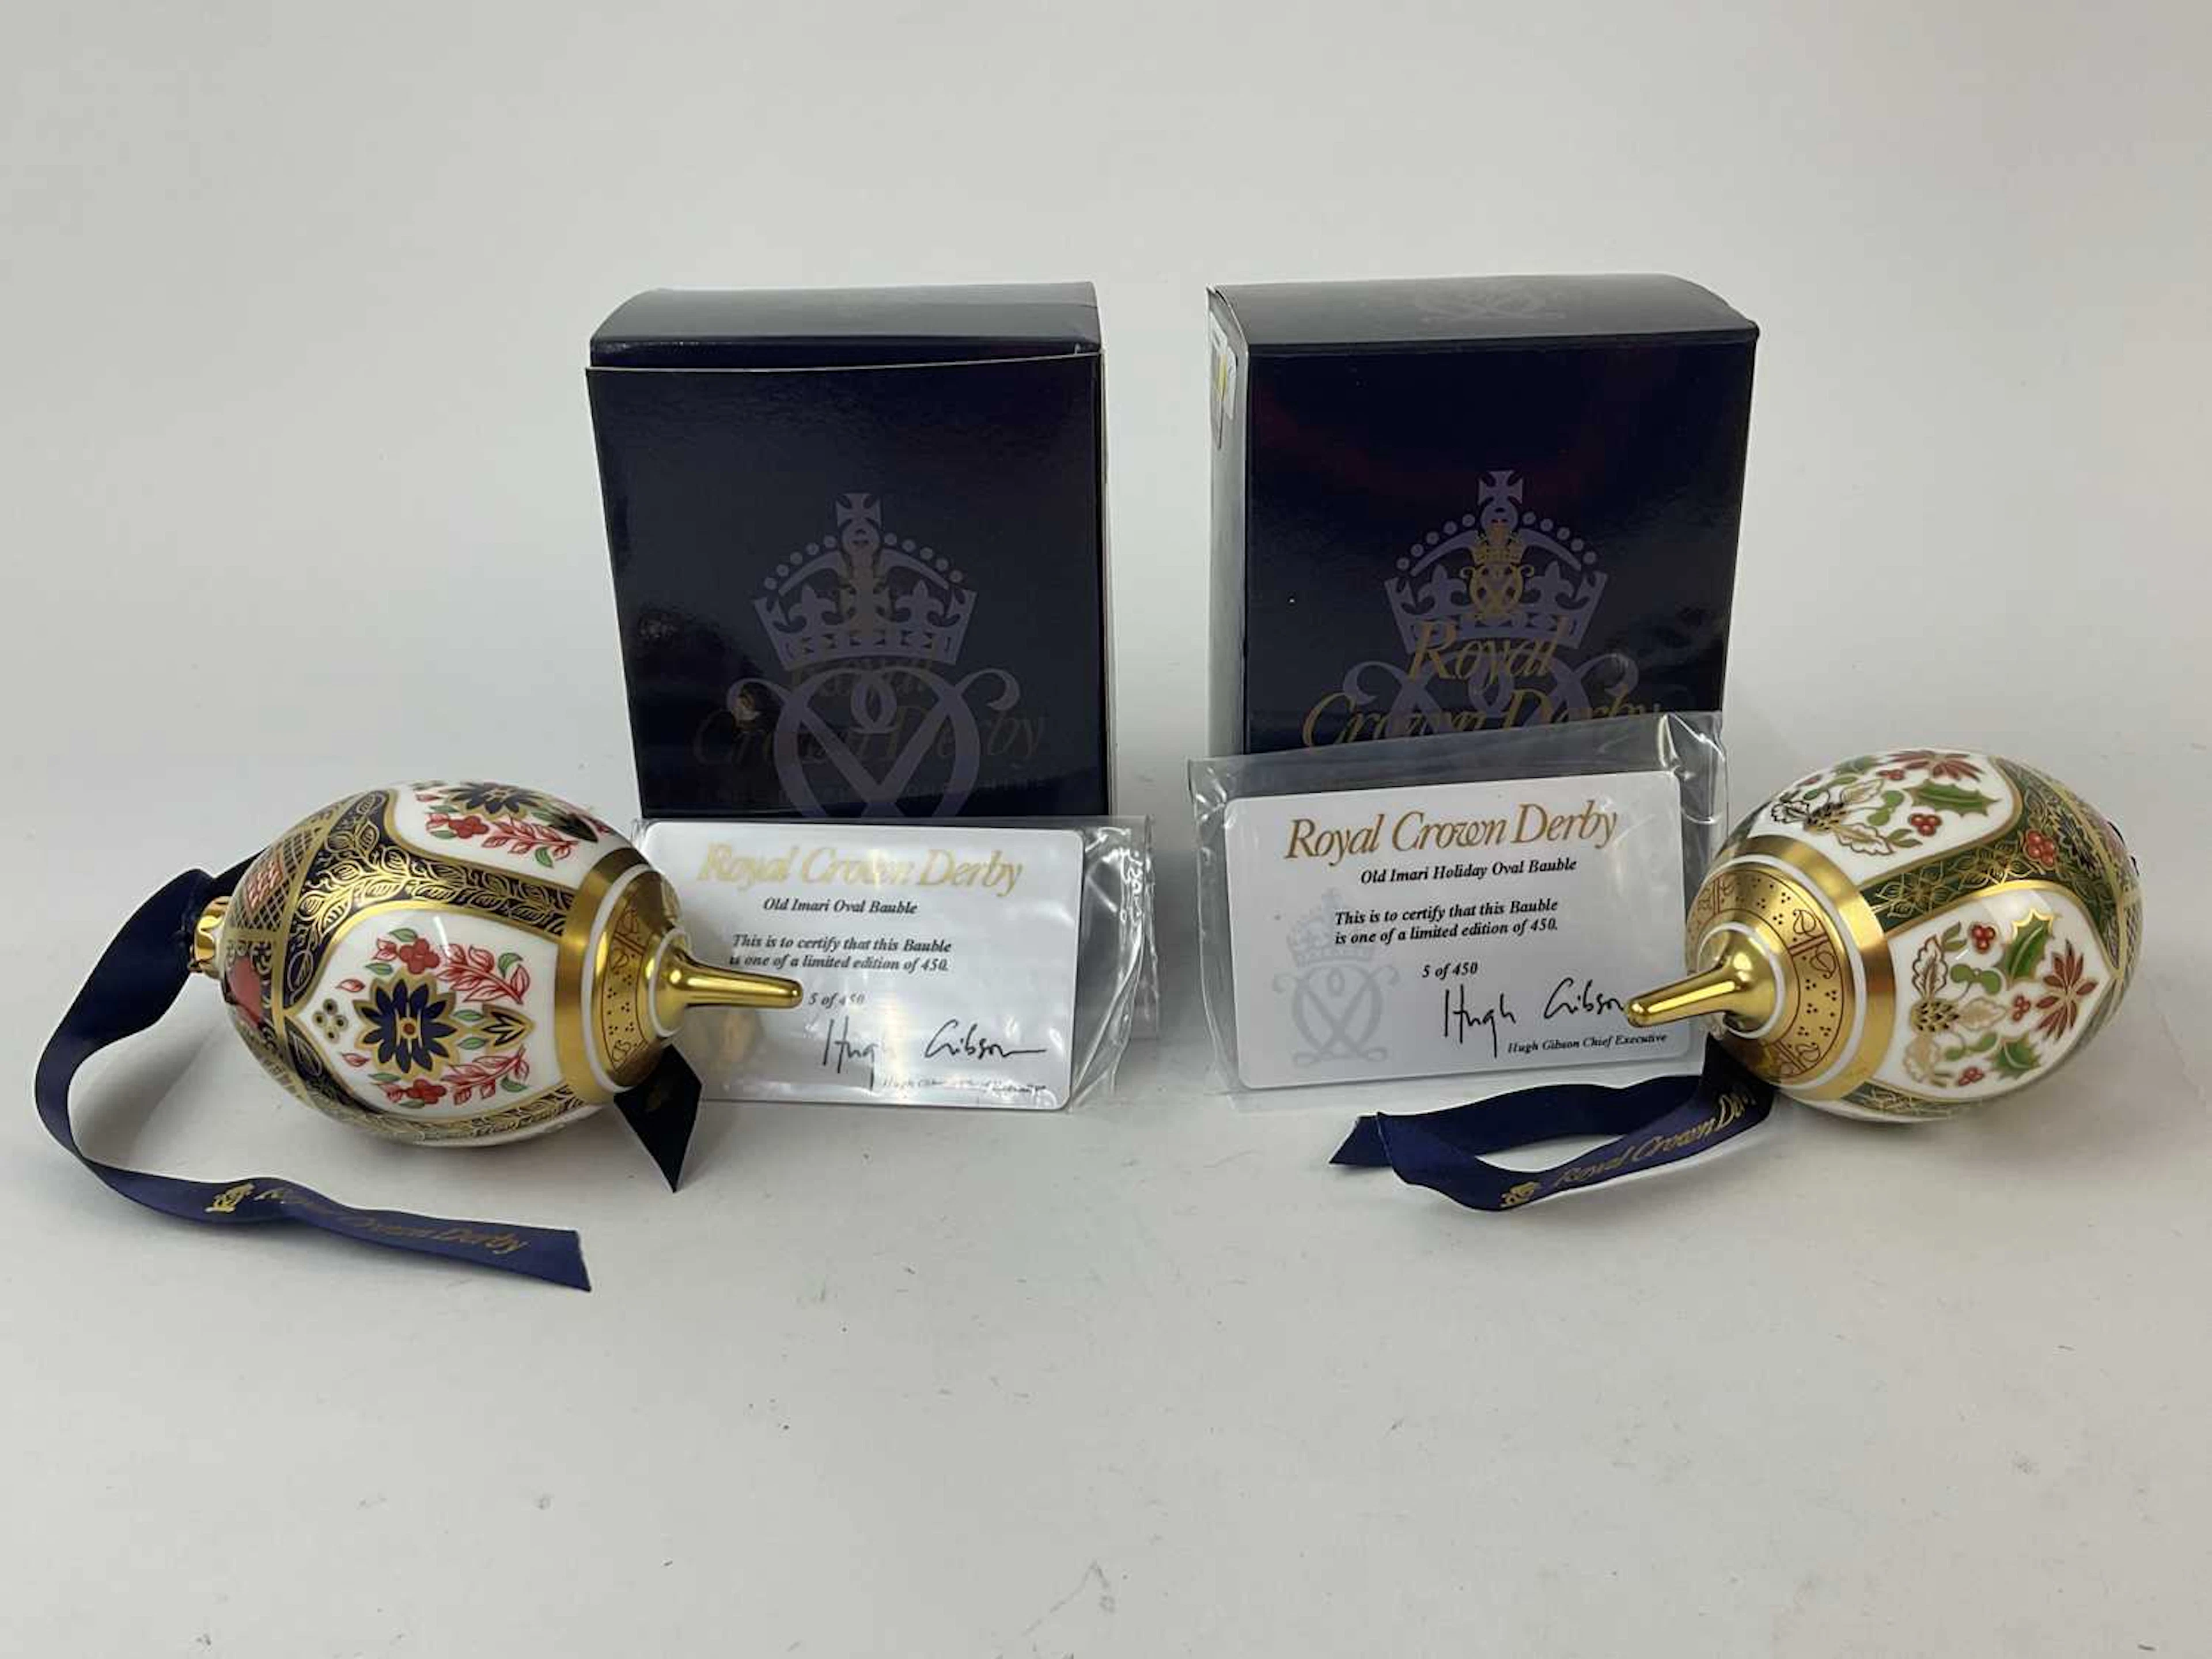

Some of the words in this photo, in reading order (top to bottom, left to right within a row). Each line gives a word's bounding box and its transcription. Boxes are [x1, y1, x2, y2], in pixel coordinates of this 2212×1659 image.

[1407, 616, 1571, 692] Royal
[1285, 813, 1384, 866] Royal
[1392, 810, 1507, 852] Crown
[1509, 800, 1618, 850] Derby
[696, 843, 800, 891] Royal
[802, 846, 916, 887] Crown
[916, 847, 1023, 897] Derby
[1361, 869, 1385, 885] Old
[1390, 865, 1428, 882] Imari
[1433, 862, 1488, 881] Holiday
[1491, 859, 1525, 876] Oval
[1528, 857, 1577, 873] Bauble
[763, 897, 788, 911] Old
[791, 898, 830, 912] Imari
[834, 899, 865, 914] Oval
[869, 900, 918, 915] Bauble
[1335, 910, 1366, 926] This
[1369, 909, 1380, 923] is
[1384, 908, 1398, 922] to
[1402, 904, 1445, 922] certify
[1449, 903, 1476, 918] that
[1479, 900, 1505, 916] this
[1509, 897, 1558, 914] Bauble
[733, 934, 762, 948] This
[766, 935, 777, 948] is
[780, 936, 793, 949] to
[797, 935, 841, 953] certify
[843, 937, 872, 951] that
[873, 938, 899, 952] this
[904, 938, 952, 953] Bauble
[1335, 932, 1347, 945] is
[1350, 933, 1376, 944] one
[1380, 927, 1396, 945] of
[1398, 930, 1407, 941] a
[1410, 924, 1458, 940] limited
[1461, 922, 1508, 937] edition
[1512, 919, 1528, 937] of
[1529, 918, 1559, 933] 450.
[744, 957, 769, 967] one
[773, 953, 788, 969] of
[790, 958, 798, 968] a
[802, 955, 849, 969] limited
[853, 957, 899, 971] edition
[904, 957, 920, 974] of
[1422, 964, 1430, 978] 5
[1434, 964, 1451, 980] of
[1452, 961, 1479, 976] 450
[808, 993, 817, 1005] 5
[821, 993, 839, 1009] of
[1443, 983, 1517, 1059] Hugh
[1544, 977, 1625, 1020] Gibson
[823, 1016, 880, 1090] Hug
[925, 1018, 1047, 1059] Gibson
[1508, 1041, 1539, 1054] Hugh
[1542, 1039, 1580, 1051] Gibson
[1583, 1036, 1612, 1048] Chief
[1615, 1033, 1668, 1046] Executive
